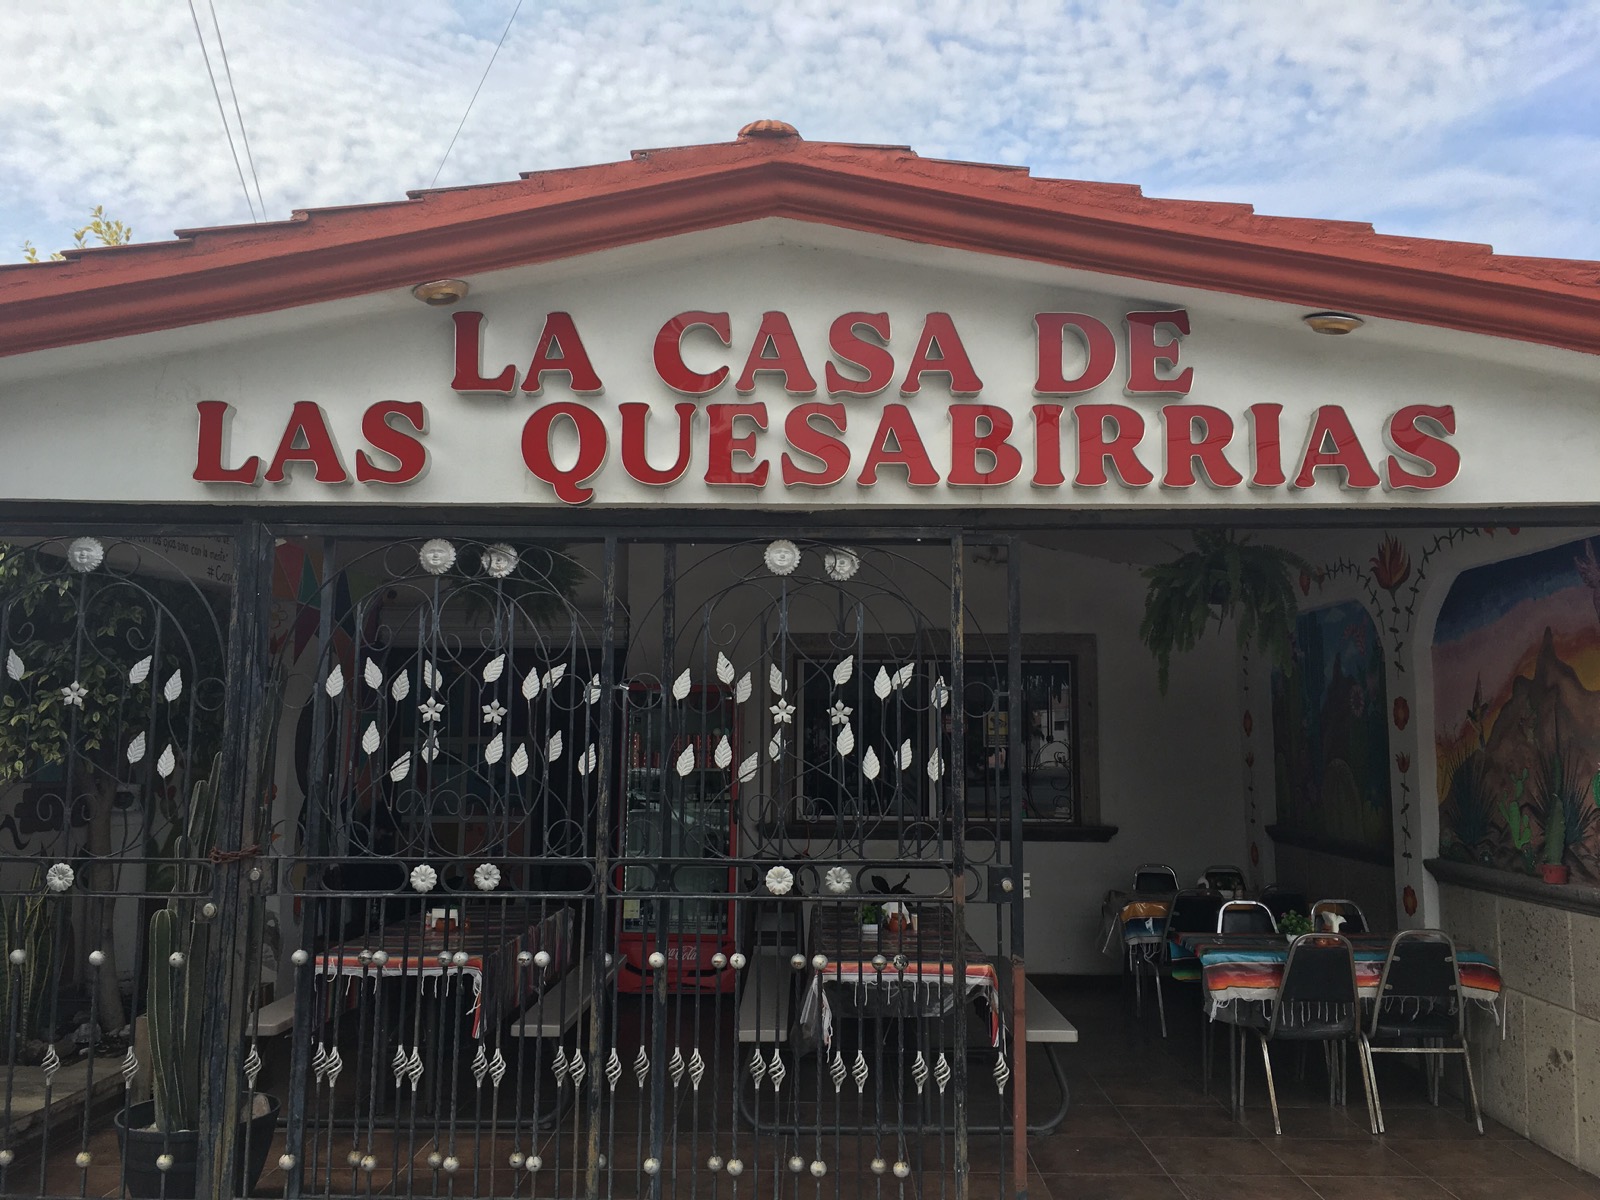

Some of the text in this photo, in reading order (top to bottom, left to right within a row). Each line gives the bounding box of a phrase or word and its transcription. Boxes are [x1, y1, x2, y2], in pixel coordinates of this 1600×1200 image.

[451, 309, 1193, 398] LA CASA DE
[193, 400, 1462, 505] LAS QUESABIRRIAS
[190, 546, 202, 557] con
